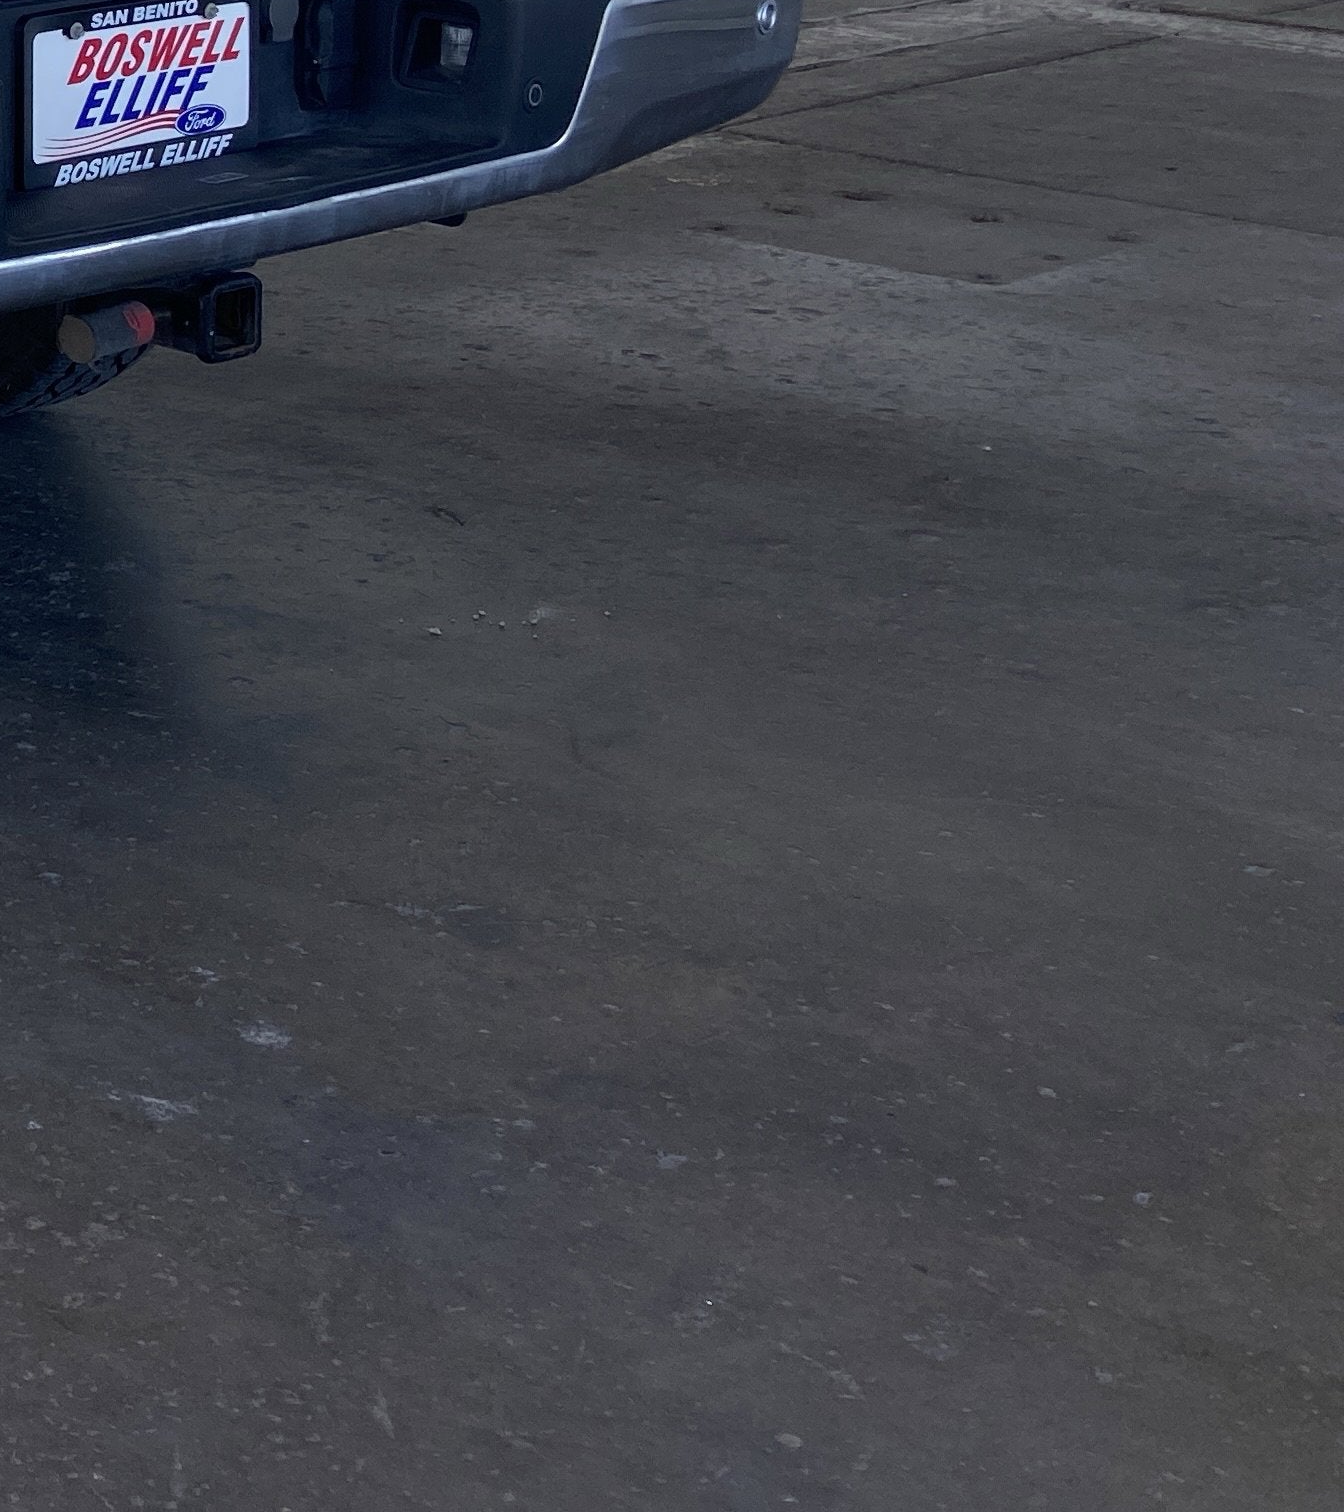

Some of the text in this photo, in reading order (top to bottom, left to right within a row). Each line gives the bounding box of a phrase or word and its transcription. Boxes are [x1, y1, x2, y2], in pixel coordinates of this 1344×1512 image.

[90, 9, 128, 29] SAN
[67, 17, 245, 85] BOSWELL
[75, 65, 215, 130] ELLIFF
[184, 109, 217, 131] Ford
[54, 134, 234, 188] BOSWELL ELLIFF
